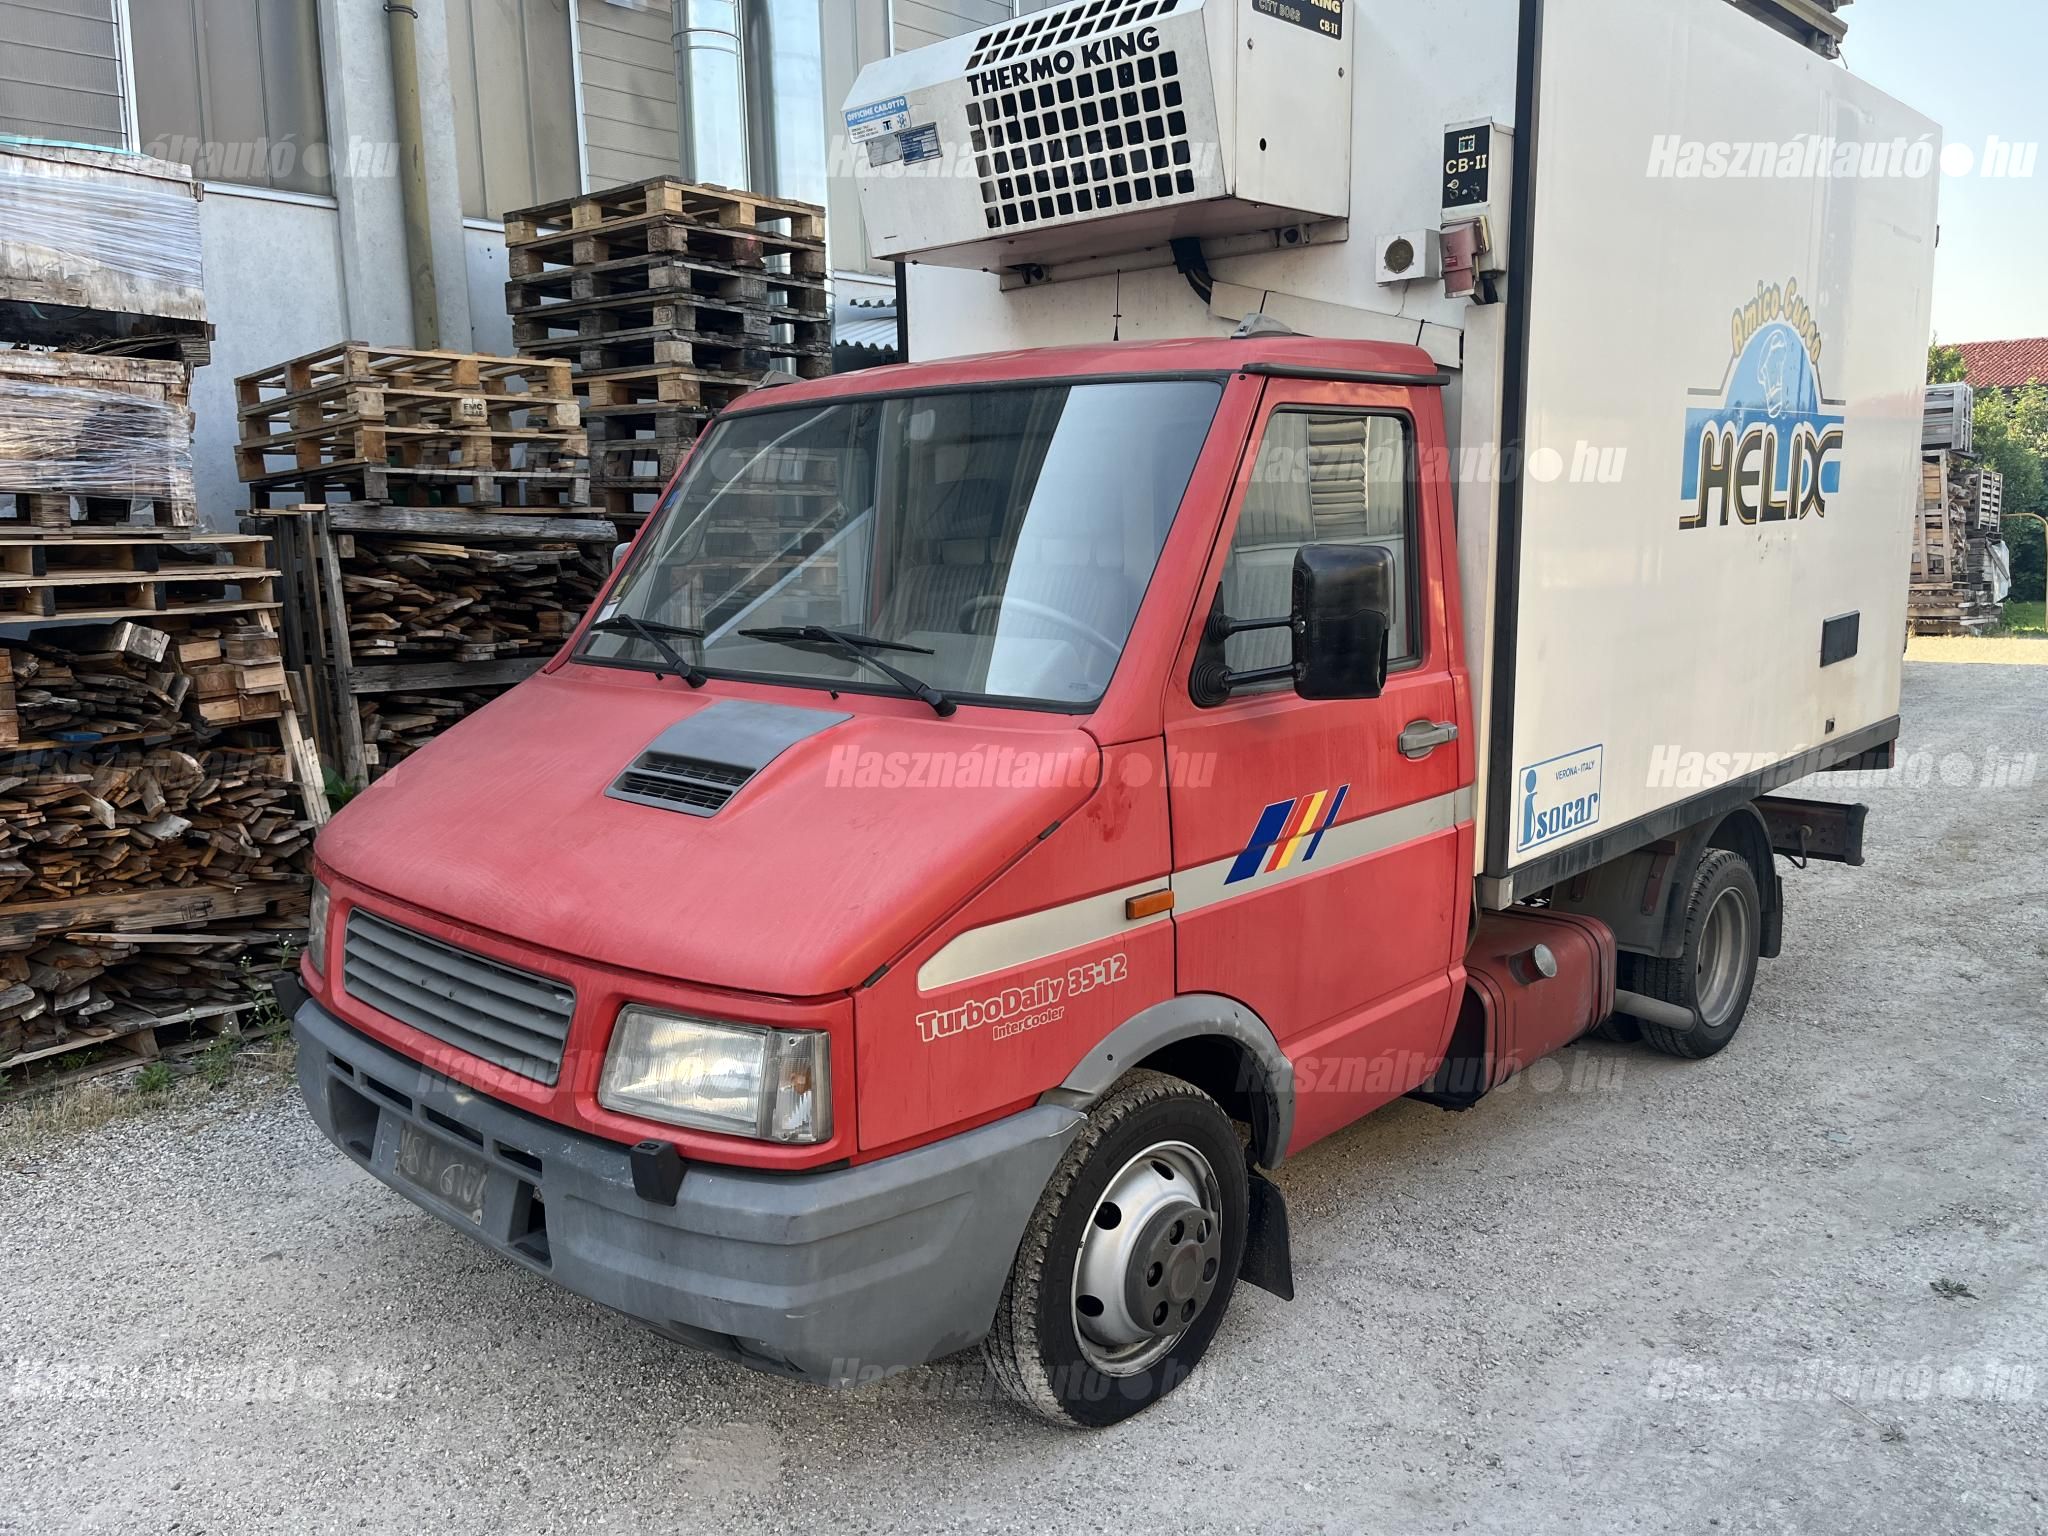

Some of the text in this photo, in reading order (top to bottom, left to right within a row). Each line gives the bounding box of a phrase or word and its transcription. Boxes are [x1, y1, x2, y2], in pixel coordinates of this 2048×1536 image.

[966, 26, 1160, 97] THERMO KING
[1445, 154, 1487, 175] CB-II
[1731, 276, 1822, 364] Amico Cuoco
[1679, 429, 1843, 530] HELIX
[916, 953, 1128, 1042] TurboDaily 35-12
